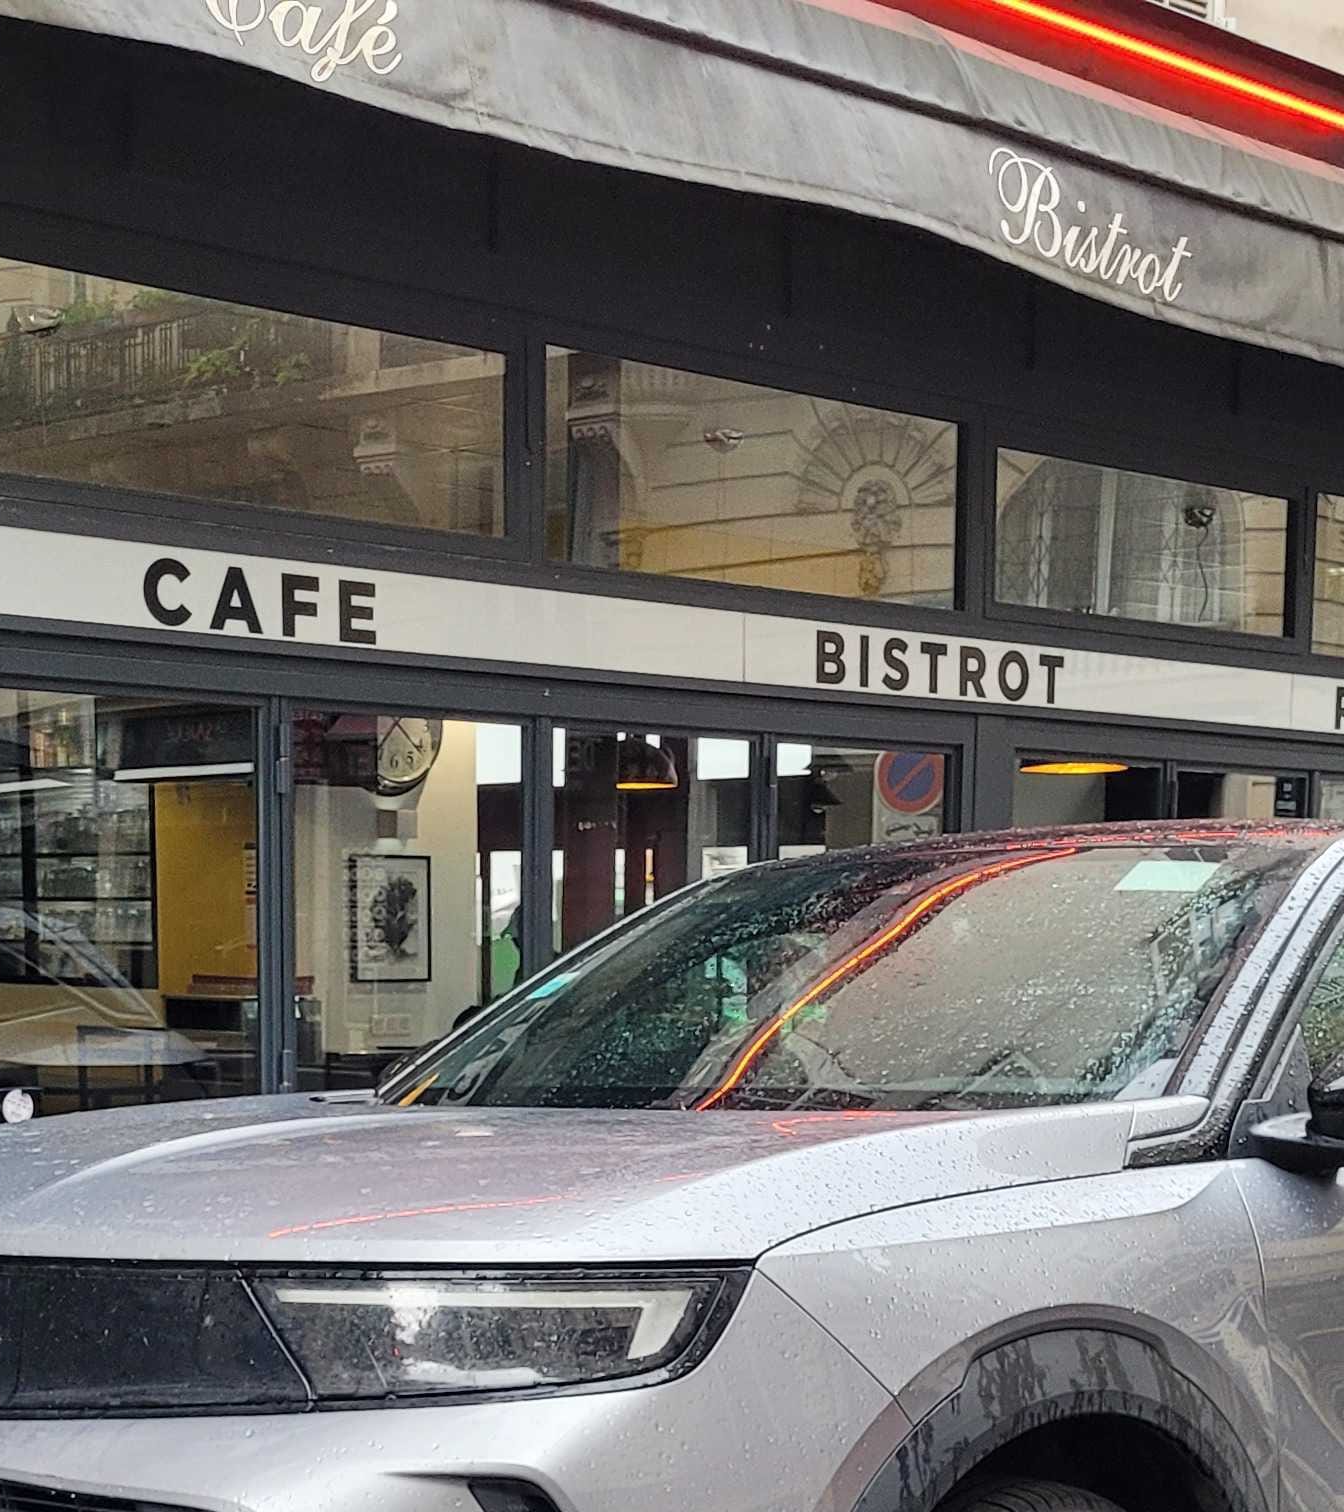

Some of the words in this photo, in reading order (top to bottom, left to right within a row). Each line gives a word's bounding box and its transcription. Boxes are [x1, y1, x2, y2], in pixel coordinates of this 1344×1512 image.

[988, 147, 1193, 302] Bistrot
[142, 557, 377, 646] CAFE
[815, 629, 1065, 705] BISTROT
